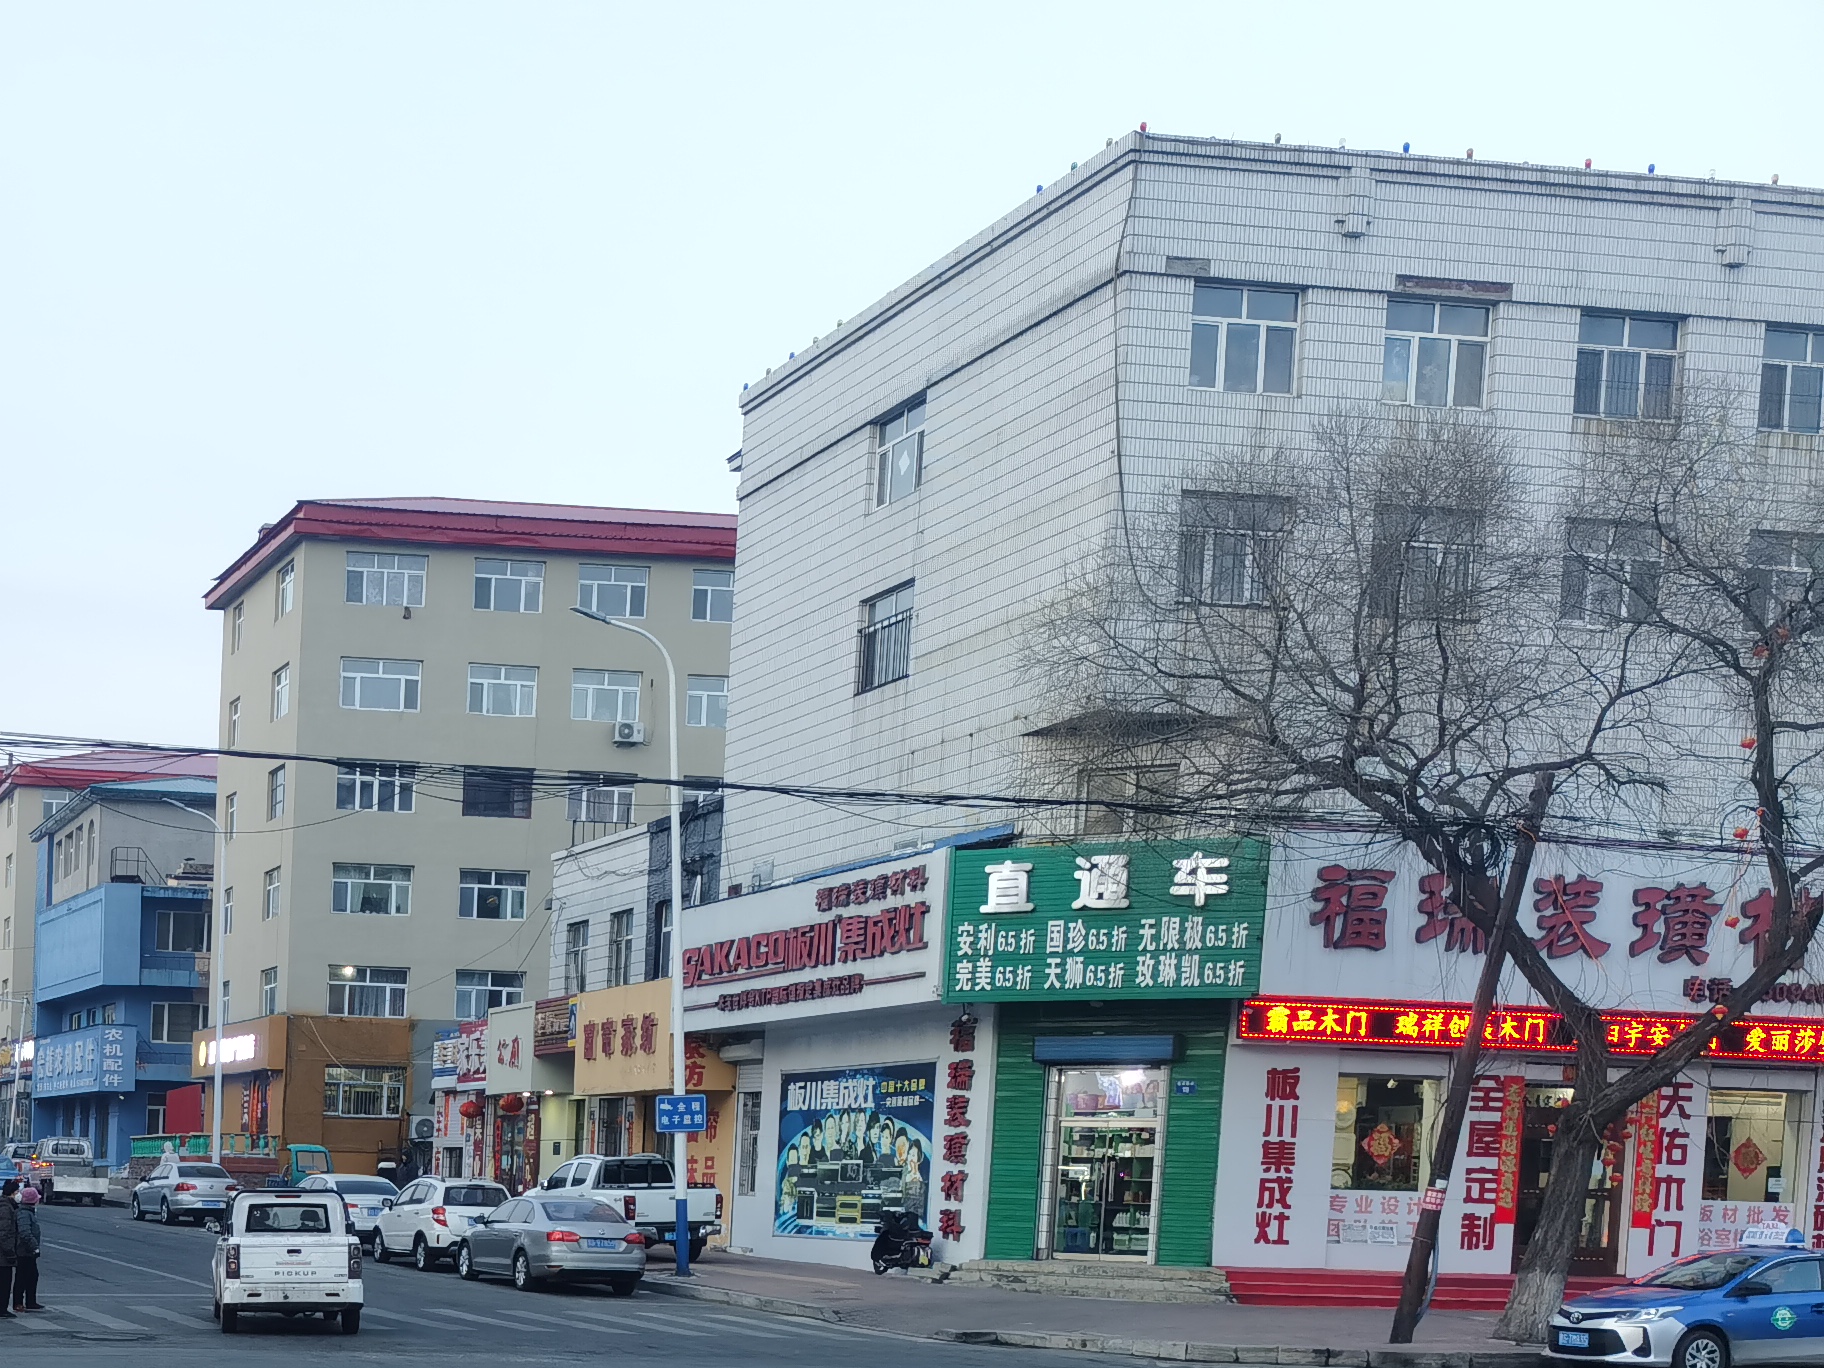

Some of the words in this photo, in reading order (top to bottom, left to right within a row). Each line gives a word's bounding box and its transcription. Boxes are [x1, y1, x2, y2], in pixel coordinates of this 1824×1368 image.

[978, 851, 1230, 914] 直通车
[956, 921, 1036, 956] 安利6.5折
[1046, 919, 1128, 954] 国珍6.5折
[1137, 915, 1249, 952] 无限极6.5折
[682, 930, 787, 987] SAKACO
[955, 957, 1032, 992] 完美6.5折
[1043, 955, 1125, 990] 天狮6.5折
[1135, 952, 1246, 988] 玫琳凯6.5折
[1683, 976, 1732, 1003] 电话
[1265, 1006, 1368, 1037] 霸品木门
[102, 1028, 124, 1087] 农机配件
[676, 1101, 701, 1112] 全程
[787, 1077, 876, 1112] 板川集成灶
[661, 1113, 703, 1125] 电子监控
[1253, 1067, 1301, 1246] 板川集成灶
[1460, 1074, 1505, 1251] 全屋定制
[1647, 1082, 1694, 1258] 天佑木门
[1329, 1193, 1424, 1216] 专业设计
